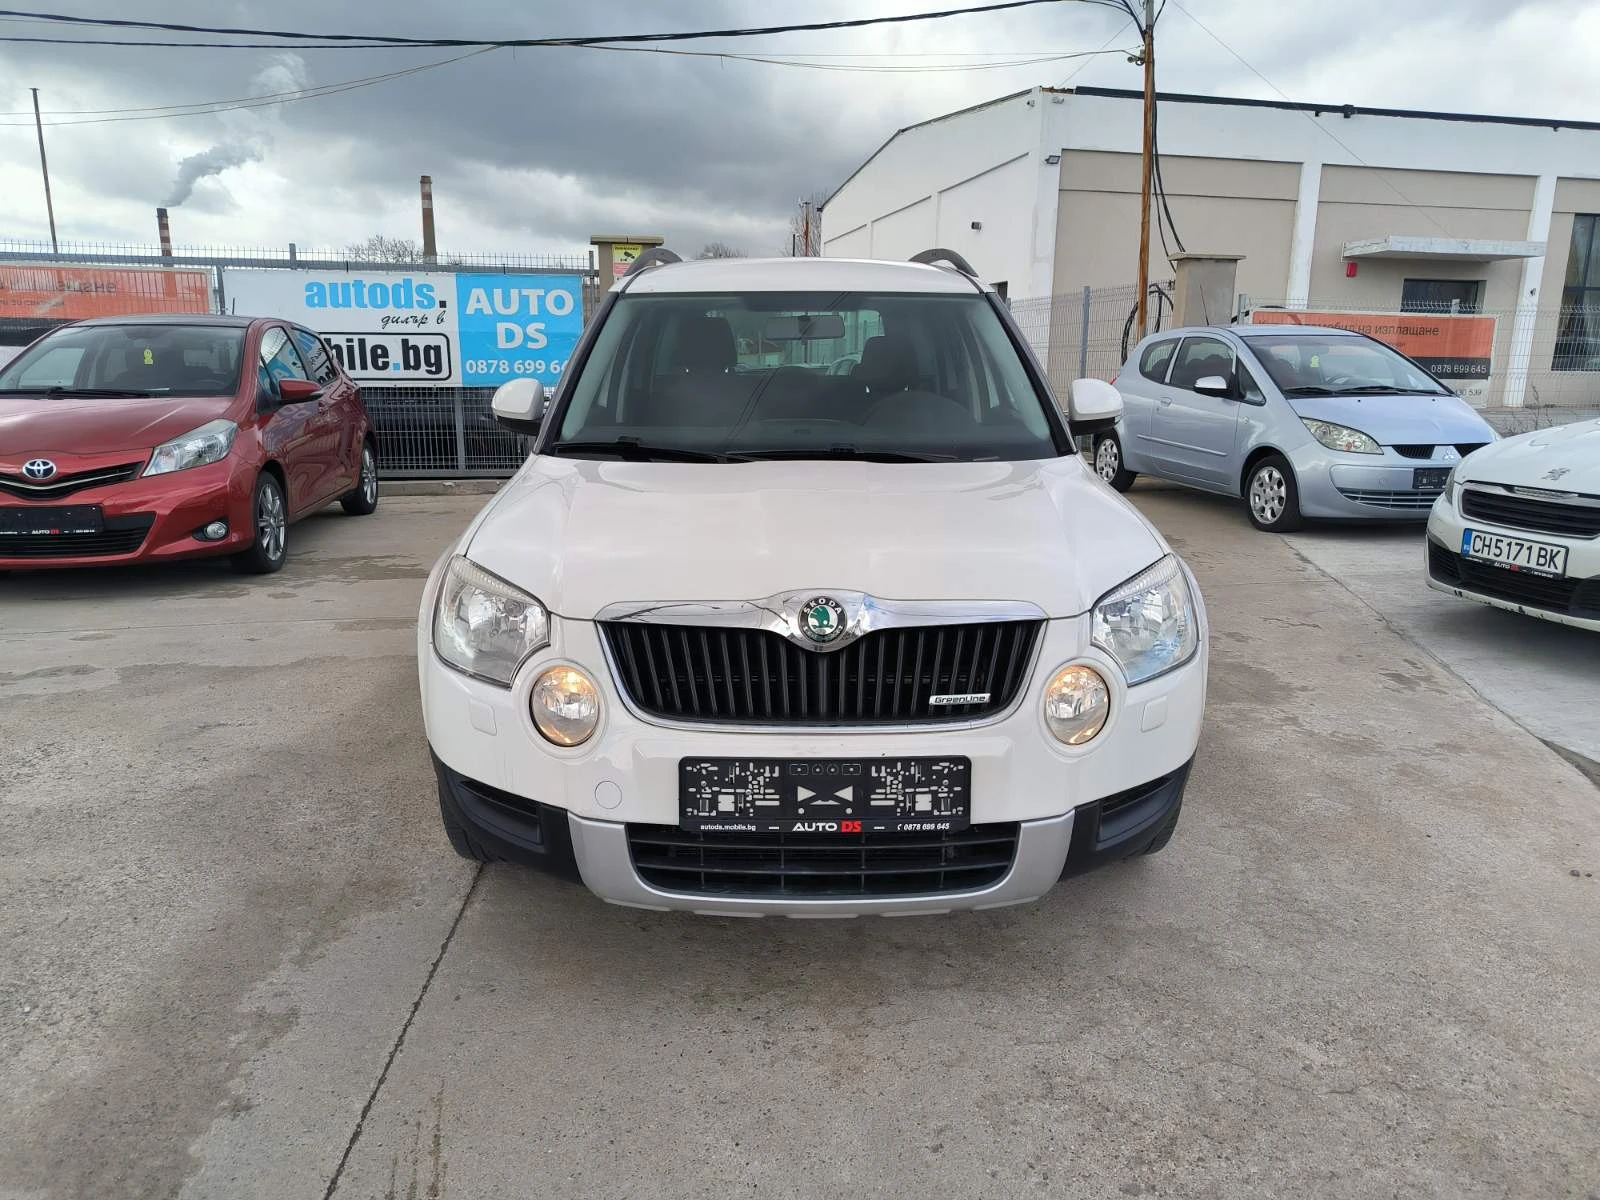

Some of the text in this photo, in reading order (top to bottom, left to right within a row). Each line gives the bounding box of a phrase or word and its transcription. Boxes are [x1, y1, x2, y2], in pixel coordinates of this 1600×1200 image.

[305, 278, 447, 309] autods.
[465, 288, 574, 316] AUTO
[496, 322, 548, 349] DS
[1375, 325, 1440, 337] изплащане
[324, 337, 442, 375] bile.bg
[466, 360, 510, 374] 0878
[514, 360, 546, 374] 699
[1431, 364, 1487, 374] 0878 699 645
[935, 696, 986, 704] GreenLine
[792, 822, 838, 832] AUTO
[842, 821, 862, 832] DS
[903, 823, 921, 831] 0878
[936, 822, 950, 830] 645
